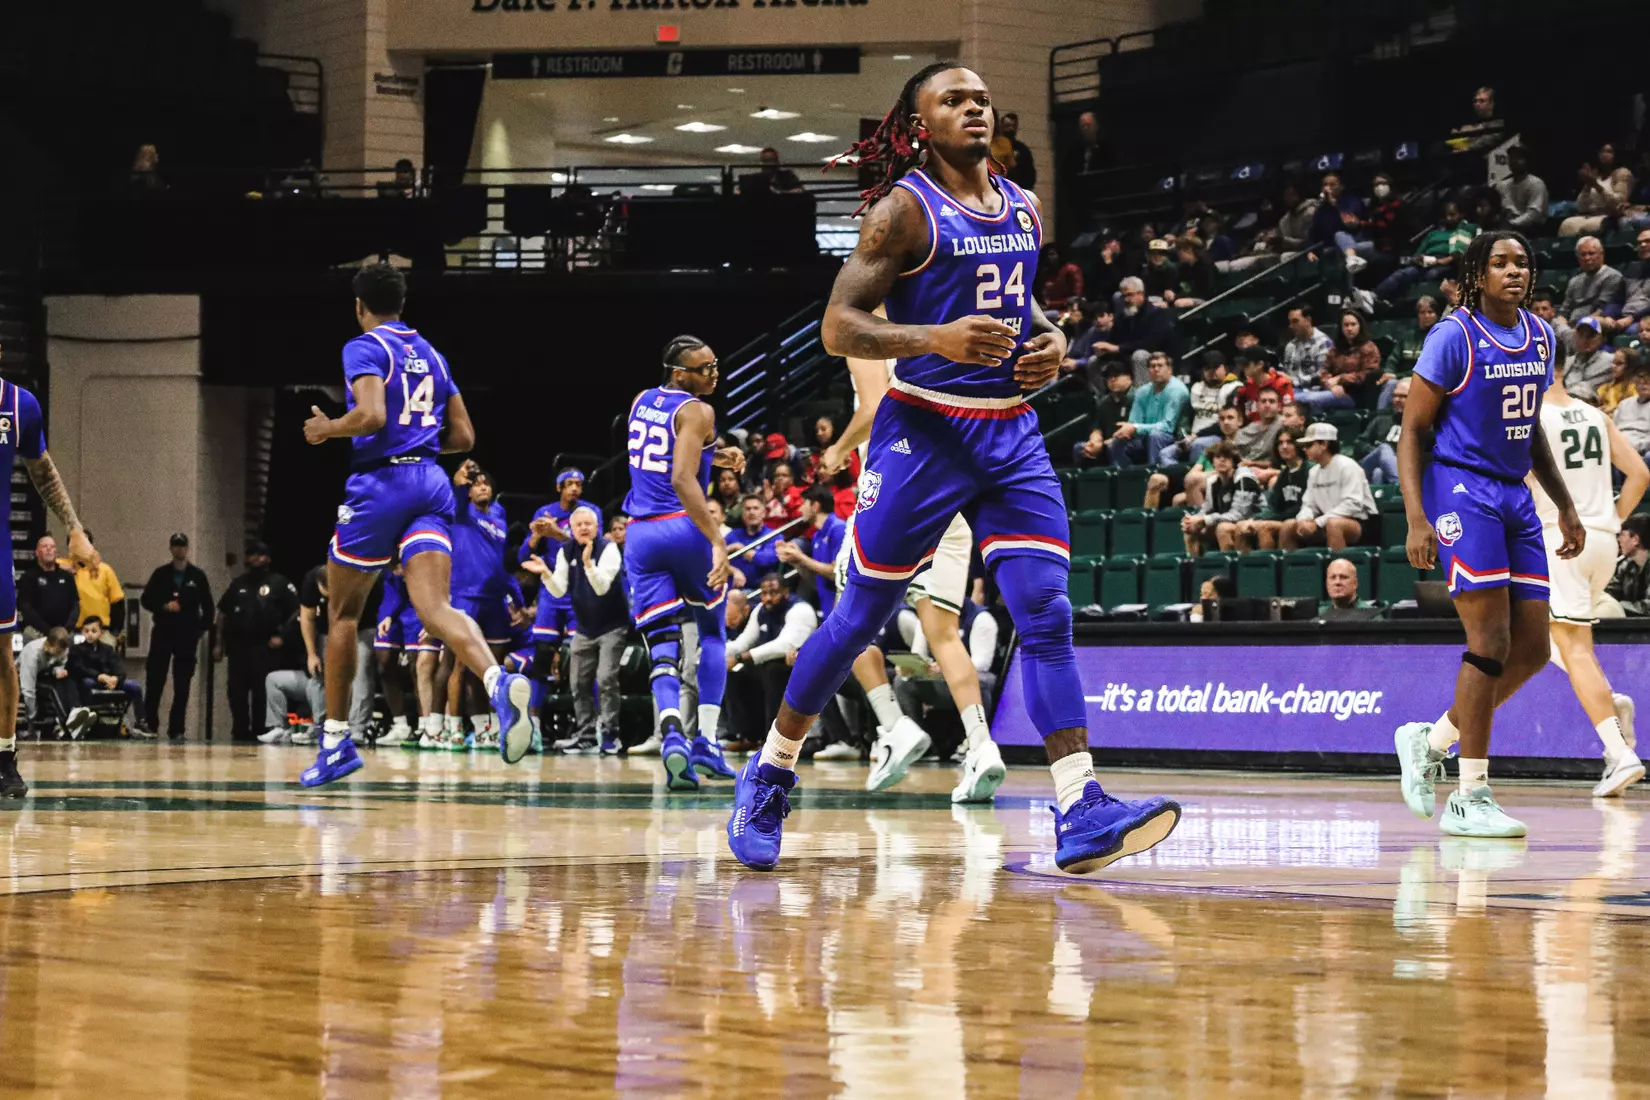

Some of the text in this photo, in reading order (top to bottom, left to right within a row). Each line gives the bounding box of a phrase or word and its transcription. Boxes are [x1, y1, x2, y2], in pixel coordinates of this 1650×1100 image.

[547, 56, 624, 73] RESTROOM
[728, 53, 806, 71] RESTROOM
[952, 234, 1036, 256] LOUISIANA
[976, 261, 1026, 310] 24
[1484, 361, 1546, 380] LOUISIANA
[398, 372, 437, 428] 14
[1502, 383, 1538, 420] 20
[627, 419, 669, 473] 22
[1560, 425, 1604, 470] 24
[1137, 687, 1151, 712] a
[1155, 681, 1213, 713] total
[1211, 681, 1384, 721] bank-changer.
